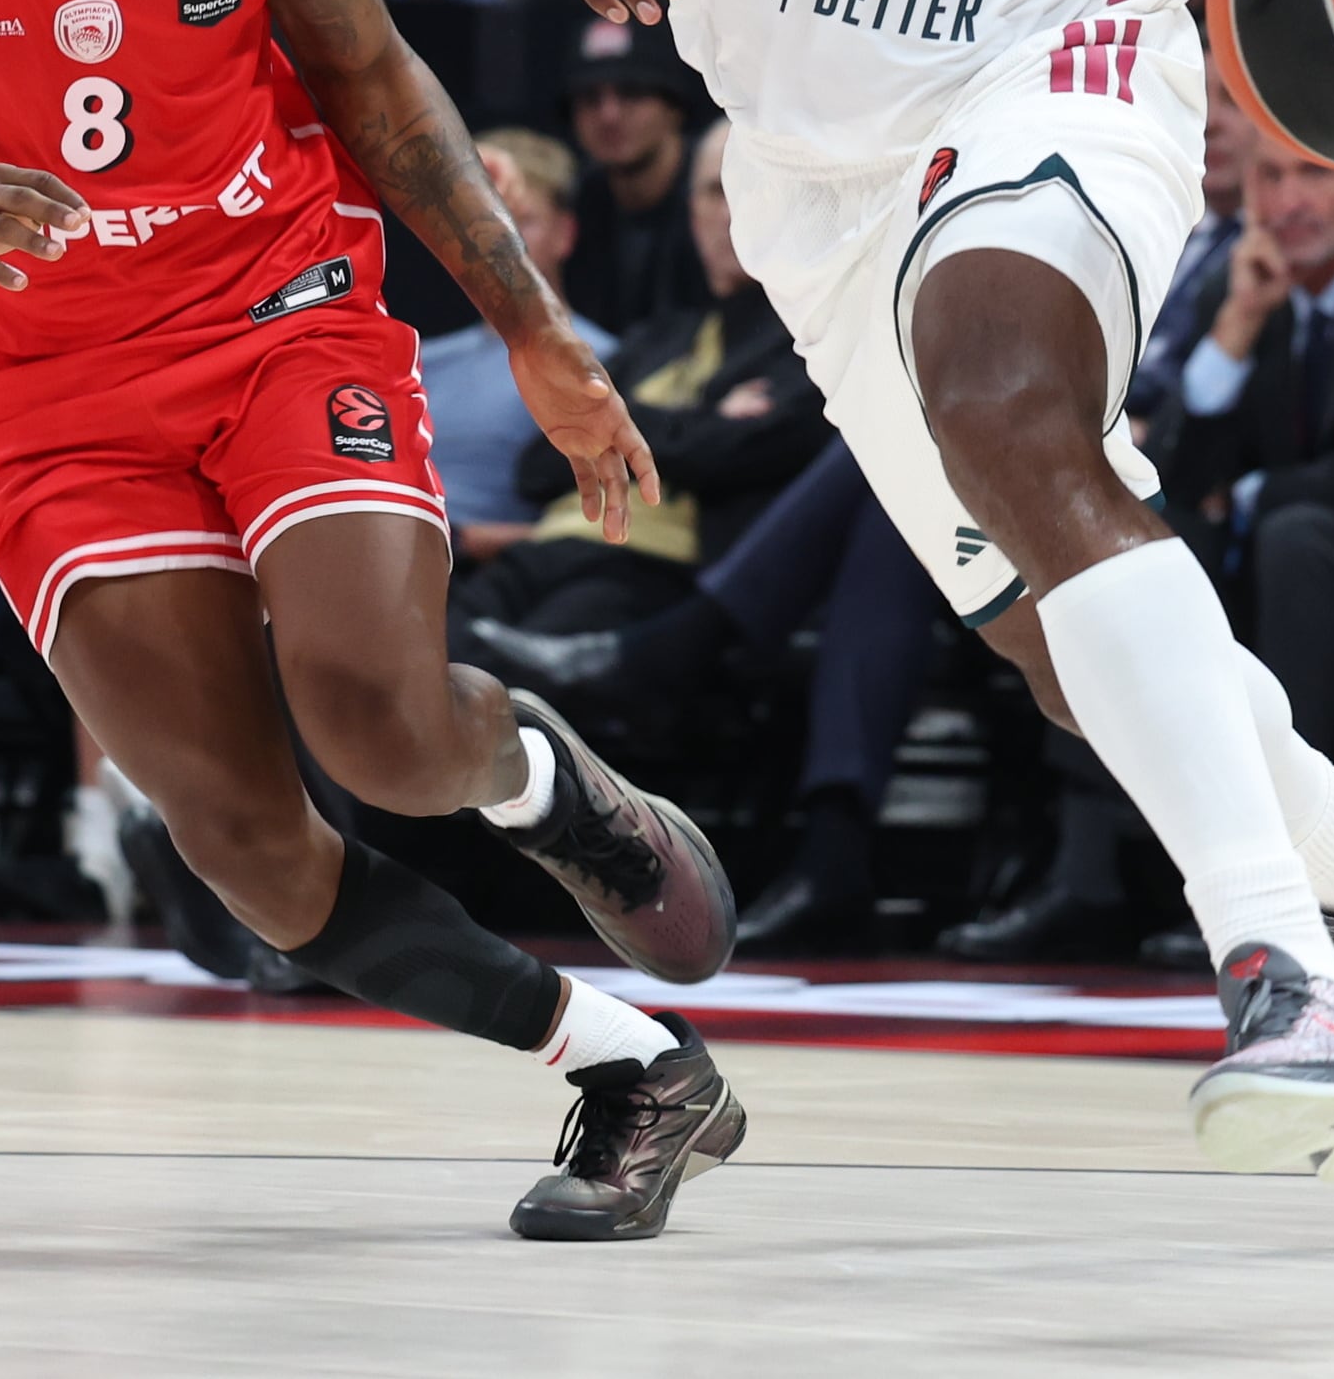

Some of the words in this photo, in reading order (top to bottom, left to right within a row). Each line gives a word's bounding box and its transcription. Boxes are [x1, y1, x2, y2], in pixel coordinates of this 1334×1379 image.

[60, 76, 132, 173] 8
[331, 268, 345, 287] M
[255, 301, 281, 314] TEAM
[335, 435, 392, 452] SuperCup
